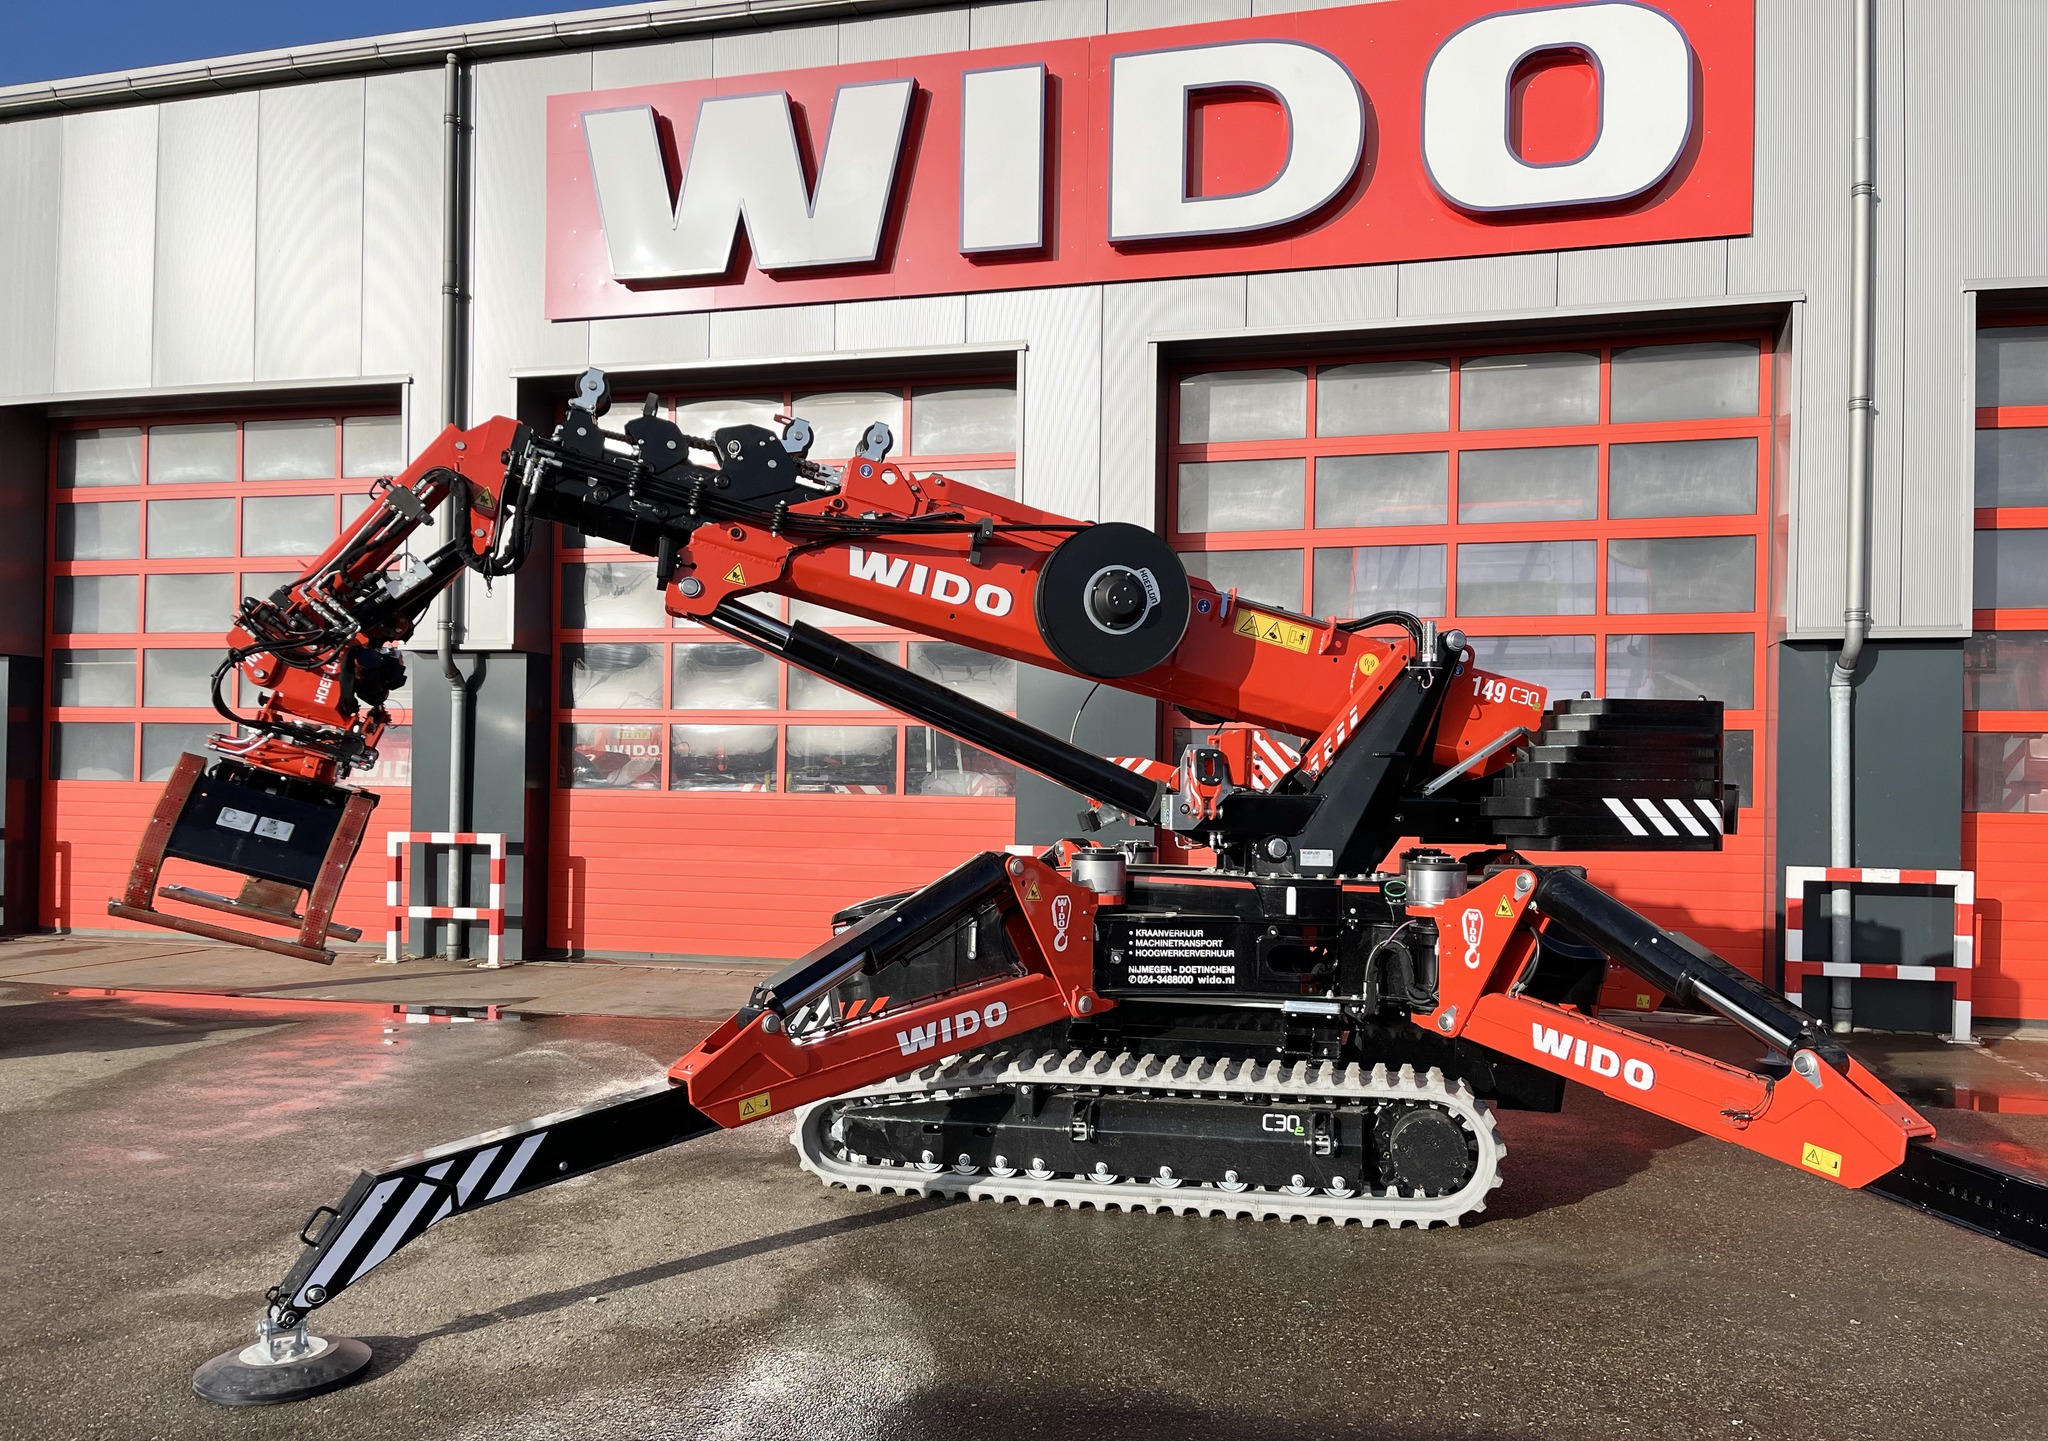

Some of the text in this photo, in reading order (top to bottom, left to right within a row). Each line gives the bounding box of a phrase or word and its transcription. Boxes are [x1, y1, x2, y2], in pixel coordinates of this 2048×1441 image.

[581, 1, 1695, 284] WIDO
[849, 545, 1014, 617] WIDO
[1139, 569, 1158, 605] HOEFLON
[1472, 676, 1507, 704] 149
[605, 744, 660, 756] WIDO
[1057, 898, 1068, 927] WIDO
[1135, 929, 1204, 938] KRAANVERHUUR
[1467, 912, 1479, 943] WIDO
[1135, 939, 1224, 948] MACHINETRANSPORT
[1135, 949, 1235, 958] HOOGWERKERVERHUUR
[1128, 965, 1172, 974] NIJMEGEN
[1178, 965, 1235, 974] DOETINCHEM
[1137, 975, 1235, 985] 024-3488000 wido.nl
[896, 1001, 1008, 1056] WIDO
[1532, 1022, 1656, 1091] WIDO
[1262, 1113, 1306, 1137] C30e
